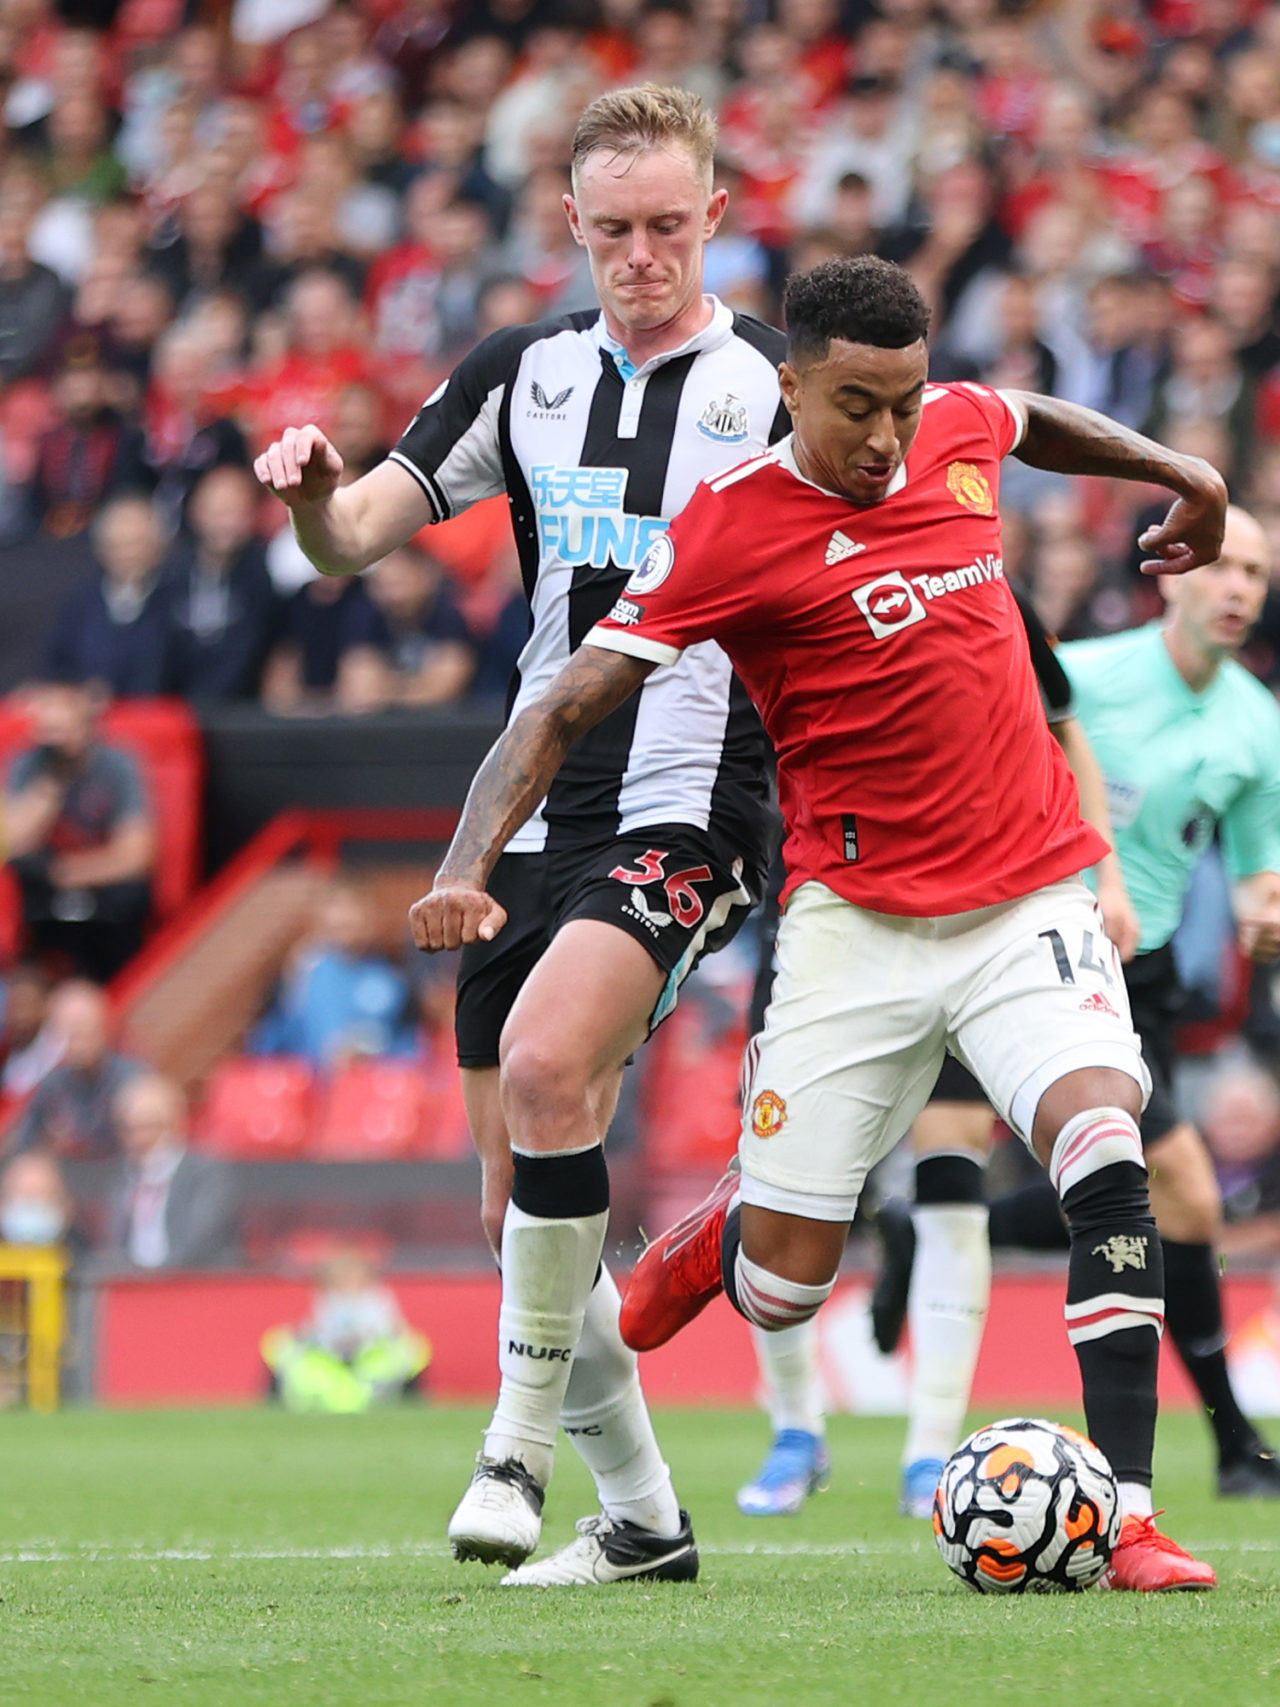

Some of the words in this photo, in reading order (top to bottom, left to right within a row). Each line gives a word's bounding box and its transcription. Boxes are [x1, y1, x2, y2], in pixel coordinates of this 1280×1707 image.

[526, 411, 567, 421] CASTORE
[608, 849, 713, 928] 36
[620, 904, 661, 939] CASTORE
[1038, 928, 1116, 991] 14
[508, 1340, 571, 1362] NUFC
